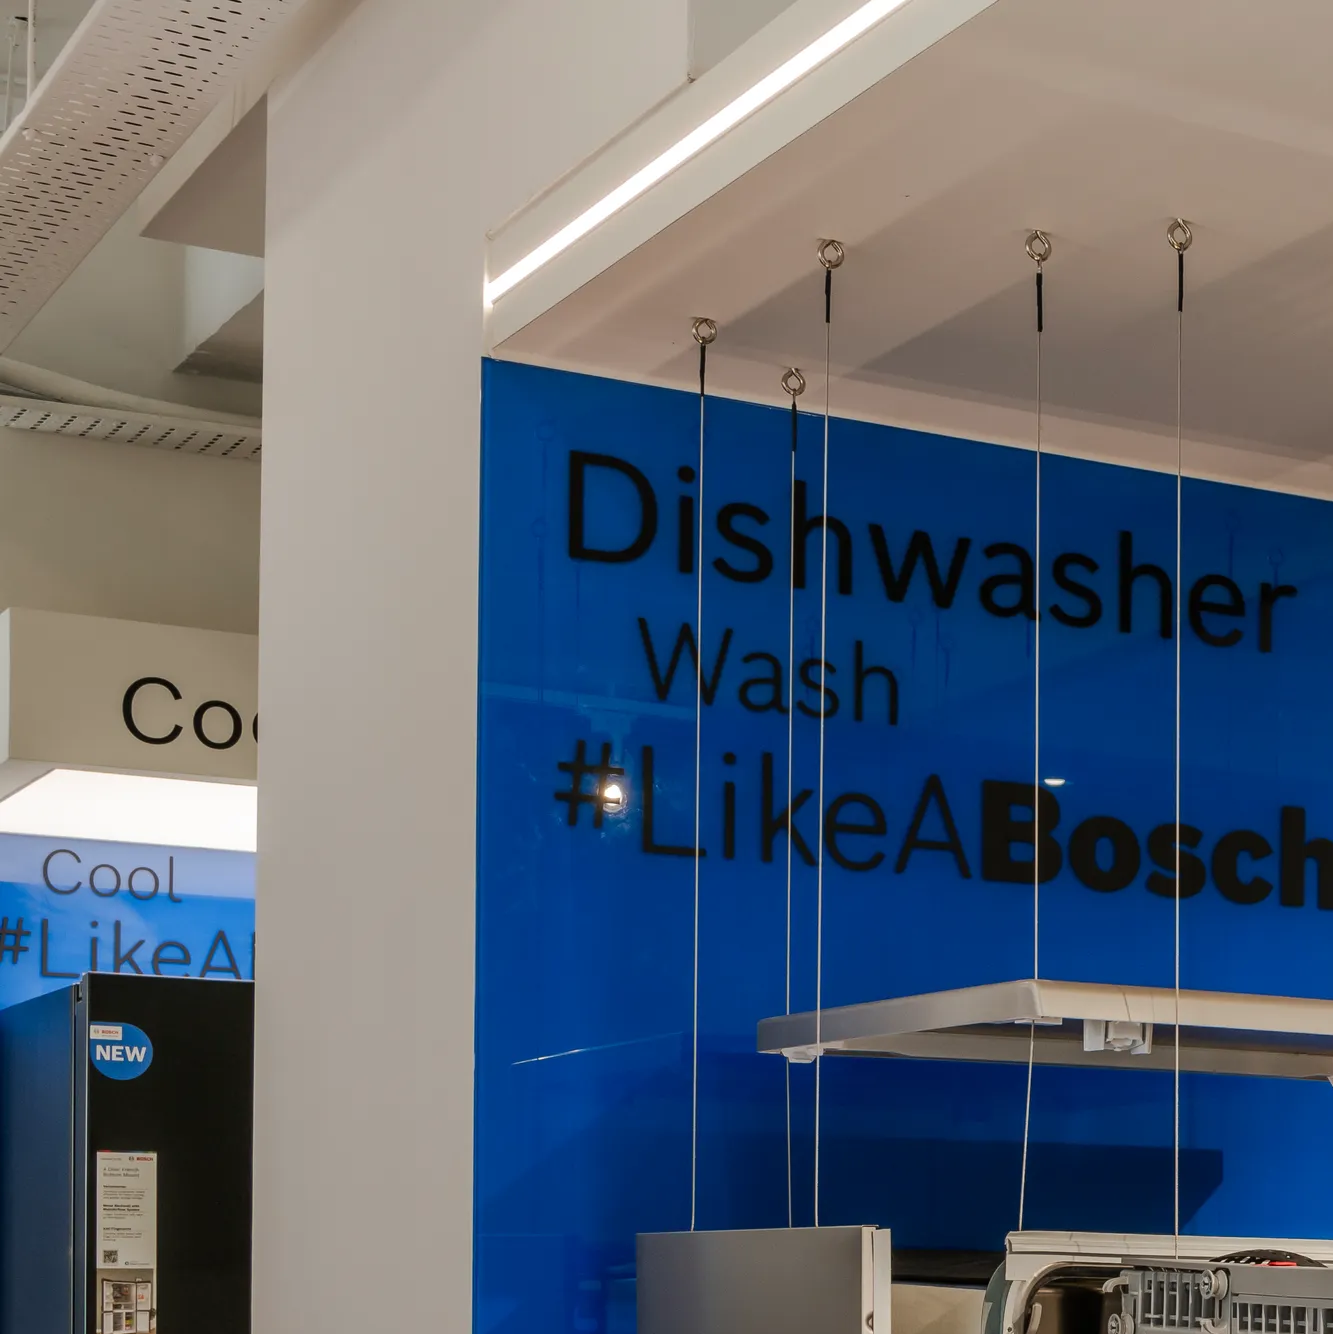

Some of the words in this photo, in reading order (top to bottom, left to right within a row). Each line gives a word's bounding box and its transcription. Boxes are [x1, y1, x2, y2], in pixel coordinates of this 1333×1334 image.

[567, 450, 1298, 653] Dishwasher
[637, 617, 900, 727] Wash
[121, 676, 259, 750] Co
[43, 849, 182, 903] Cool
[0, 916, 256, 981] #LikeA
[96, 1044, 147, 1063] NEW
